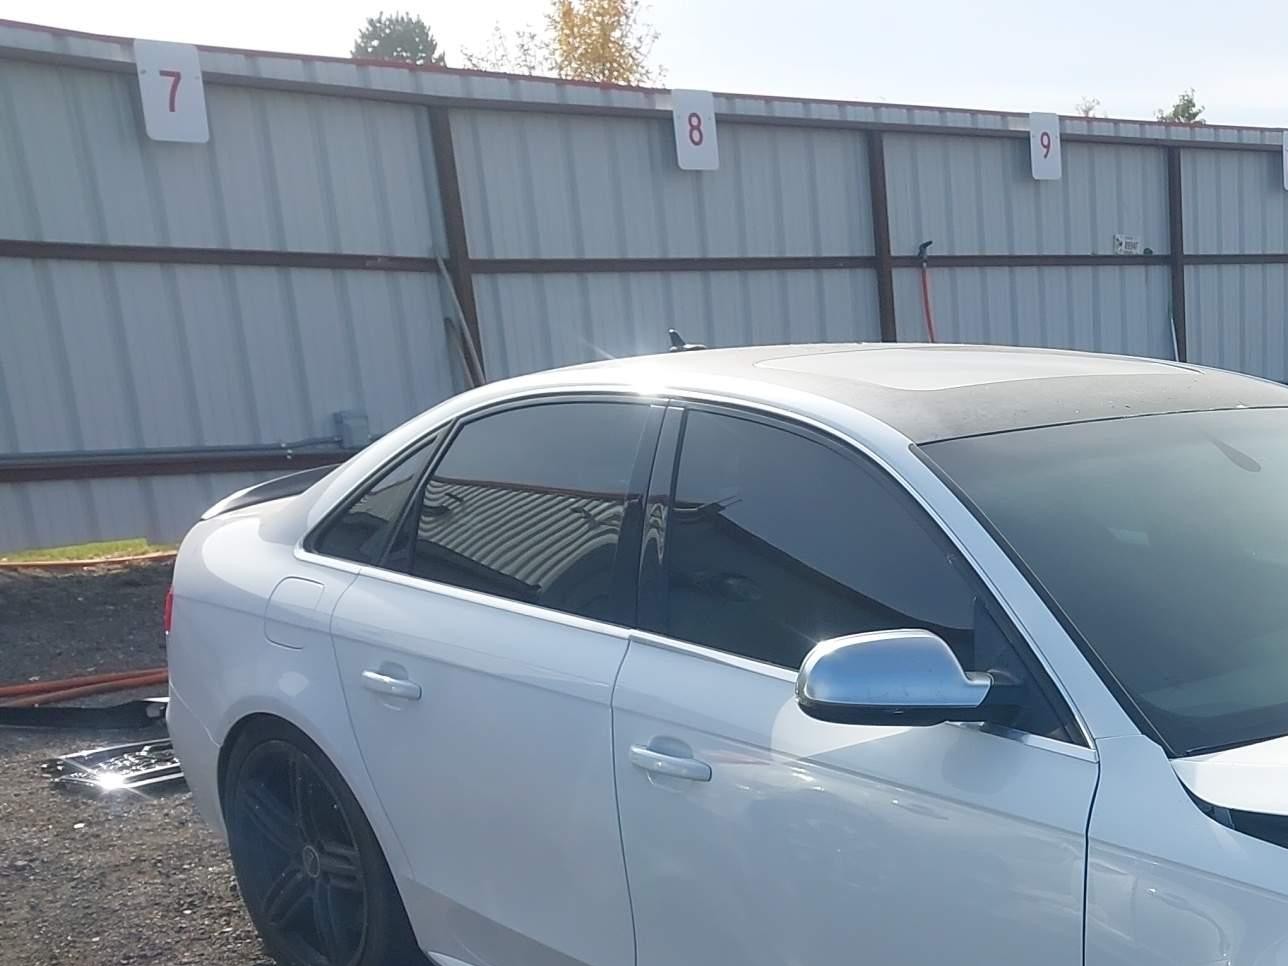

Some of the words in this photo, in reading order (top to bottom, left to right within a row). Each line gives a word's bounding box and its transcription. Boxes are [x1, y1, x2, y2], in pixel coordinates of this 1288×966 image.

[159, 70, 181, 113] 7
[688, 112, 703, 146] 8
[1040, 131, 1051, 159] 9
